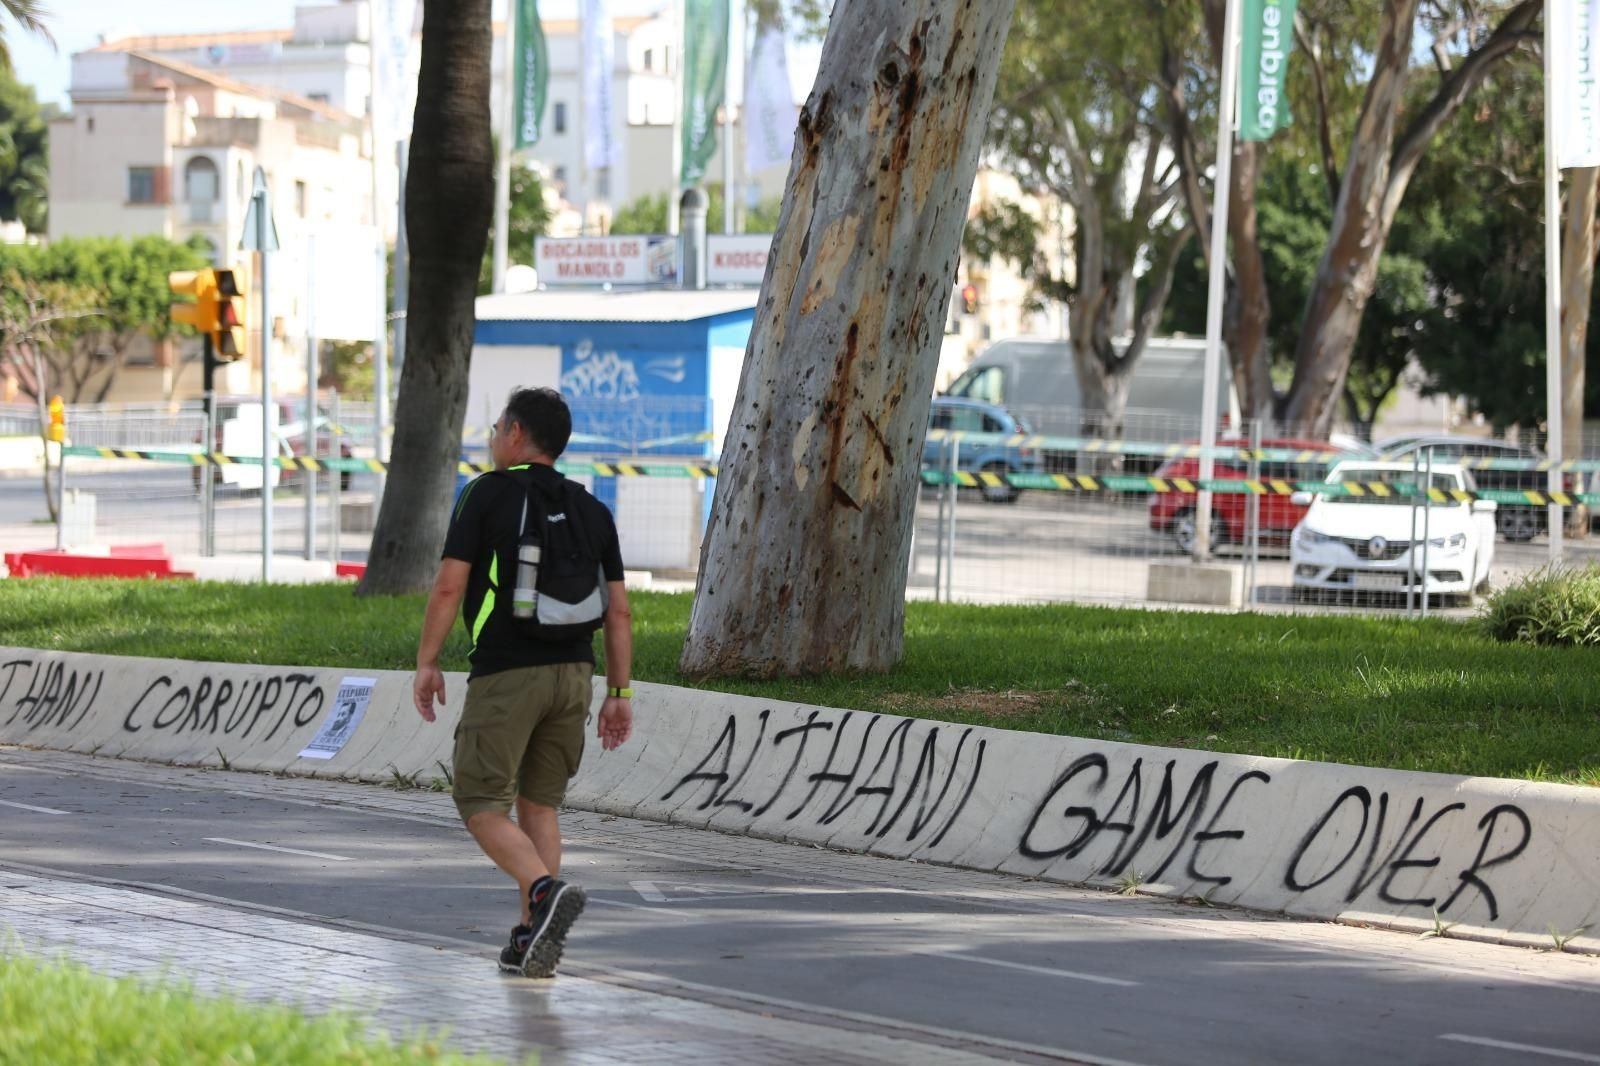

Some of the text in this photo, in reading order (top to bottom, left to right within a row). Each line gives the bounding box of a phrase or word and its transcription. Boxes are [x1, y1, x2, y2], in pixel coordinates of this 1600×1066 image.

[541, 241, 640, 259] BOCADILLOS
[713, 251, 768, 268] KIOSC
[557, 261, 626, 278] MANOLO
[123, 673, 324, 742] CORRUPTO
[661, 709, 1532, 921] ALTHANI GAME OVER
